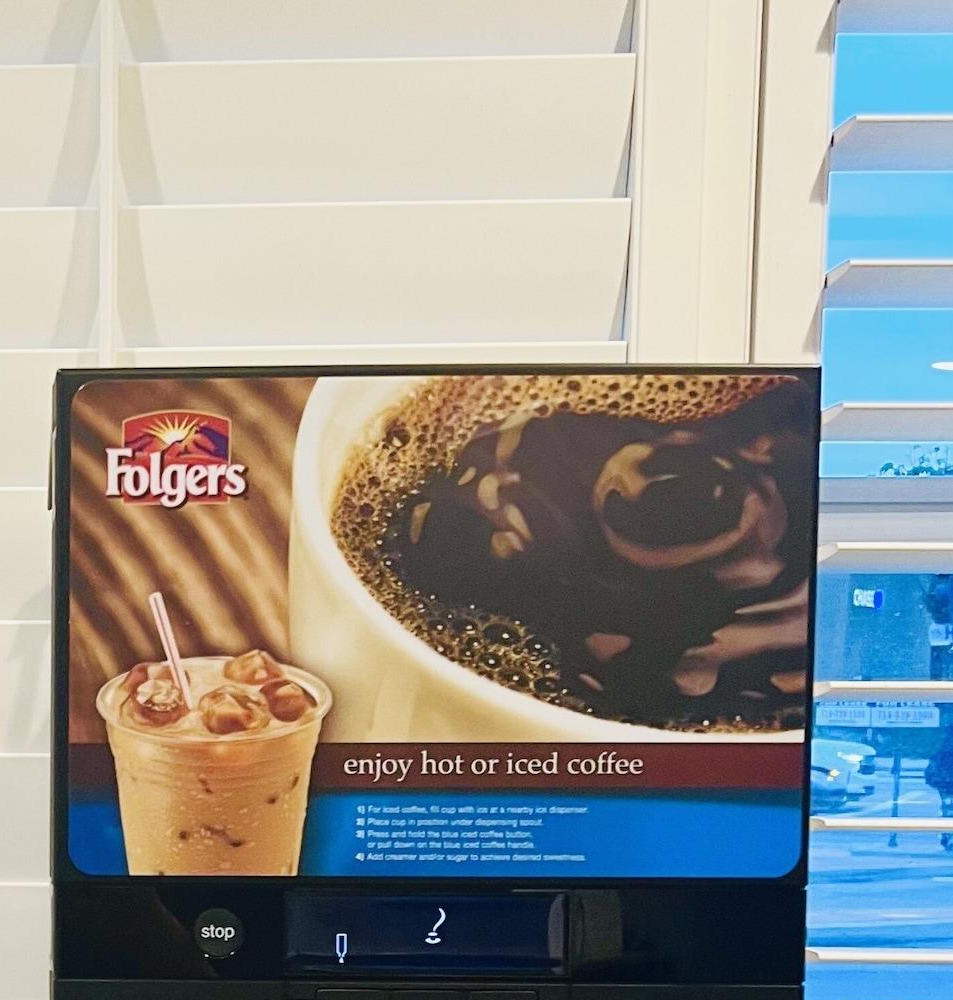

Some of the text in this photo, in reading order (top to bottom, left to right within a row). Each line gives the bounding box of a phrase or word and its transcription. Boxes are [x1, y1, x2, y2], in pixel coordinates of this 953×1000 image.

[105, 447, 246, 507] Folgers
[343, 751, 644, 782] enjoy hot or iced coffee
[367, 805, 382, 814] For
[382, 805, 400, 814] iced
[440, 807, 457, 815] cup
[458, 806, 474, 814] with
[506, 806, 534, 816] nearby
[367, 818, 390, 827] Place
[391, 819, 407, 827] cup
[417, 819, 449, 827] position
[475, 818, 518, 828] dispensing
[367, 830, 390, 838] Press
[441, 831, 459, 839] blue
[479, 830, 504, 838] coffee
[377, 841, 392, 849] pull
[393, 841, 416, 849] down
[429, 841, 442, 849] the
[443, 841, 461, 849] blue
[481, 841, 506, 849] coffee
[367, 853, 384, 861] Add
[446, 854, 468, 862] sugar
[200, 924, 236, 941] stop
